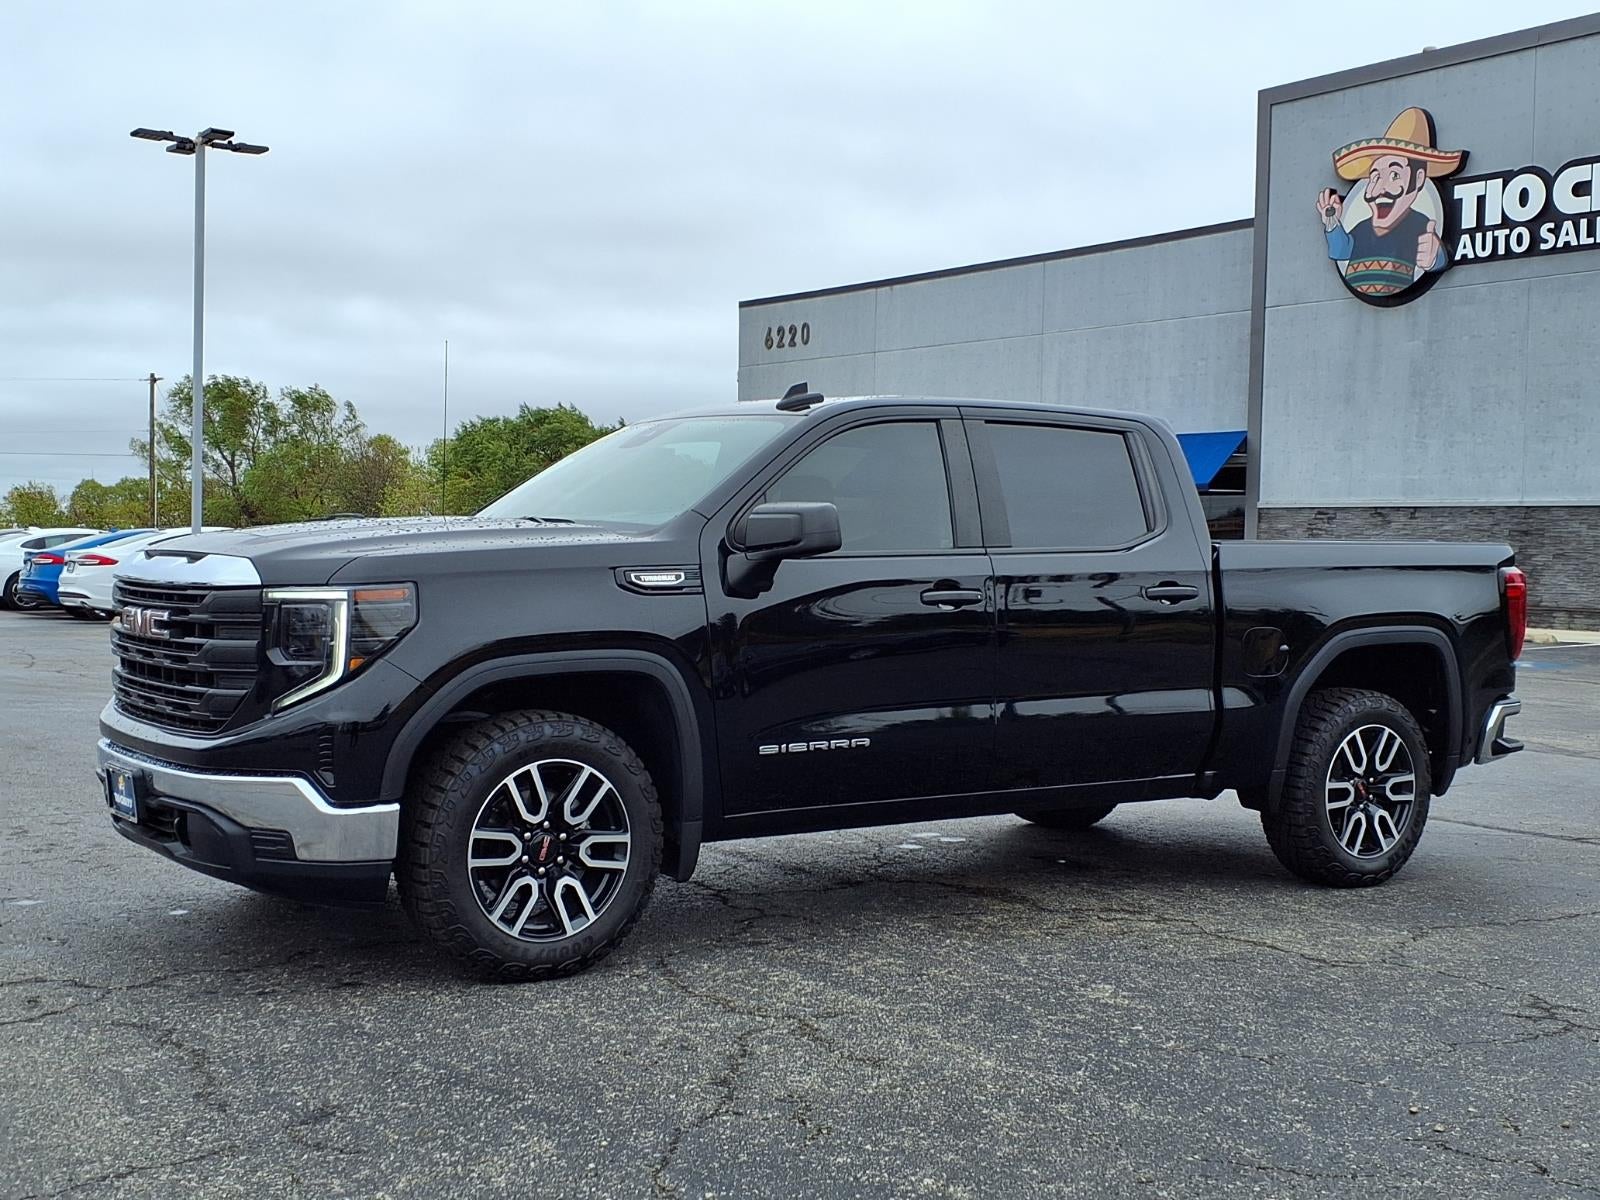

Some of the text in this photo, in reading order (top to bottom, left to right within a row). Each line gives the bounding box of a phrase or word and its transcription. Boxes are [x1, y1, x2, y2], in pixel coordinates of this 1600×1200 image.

[1453, 173, 1547, 230] TIO
[1454, 226, 1531, 261] AUTO
[764, 321, 811, 351] 6220
[122, 606, 170, 639] GMC
[759, 738, 871, 755] SIERRA
